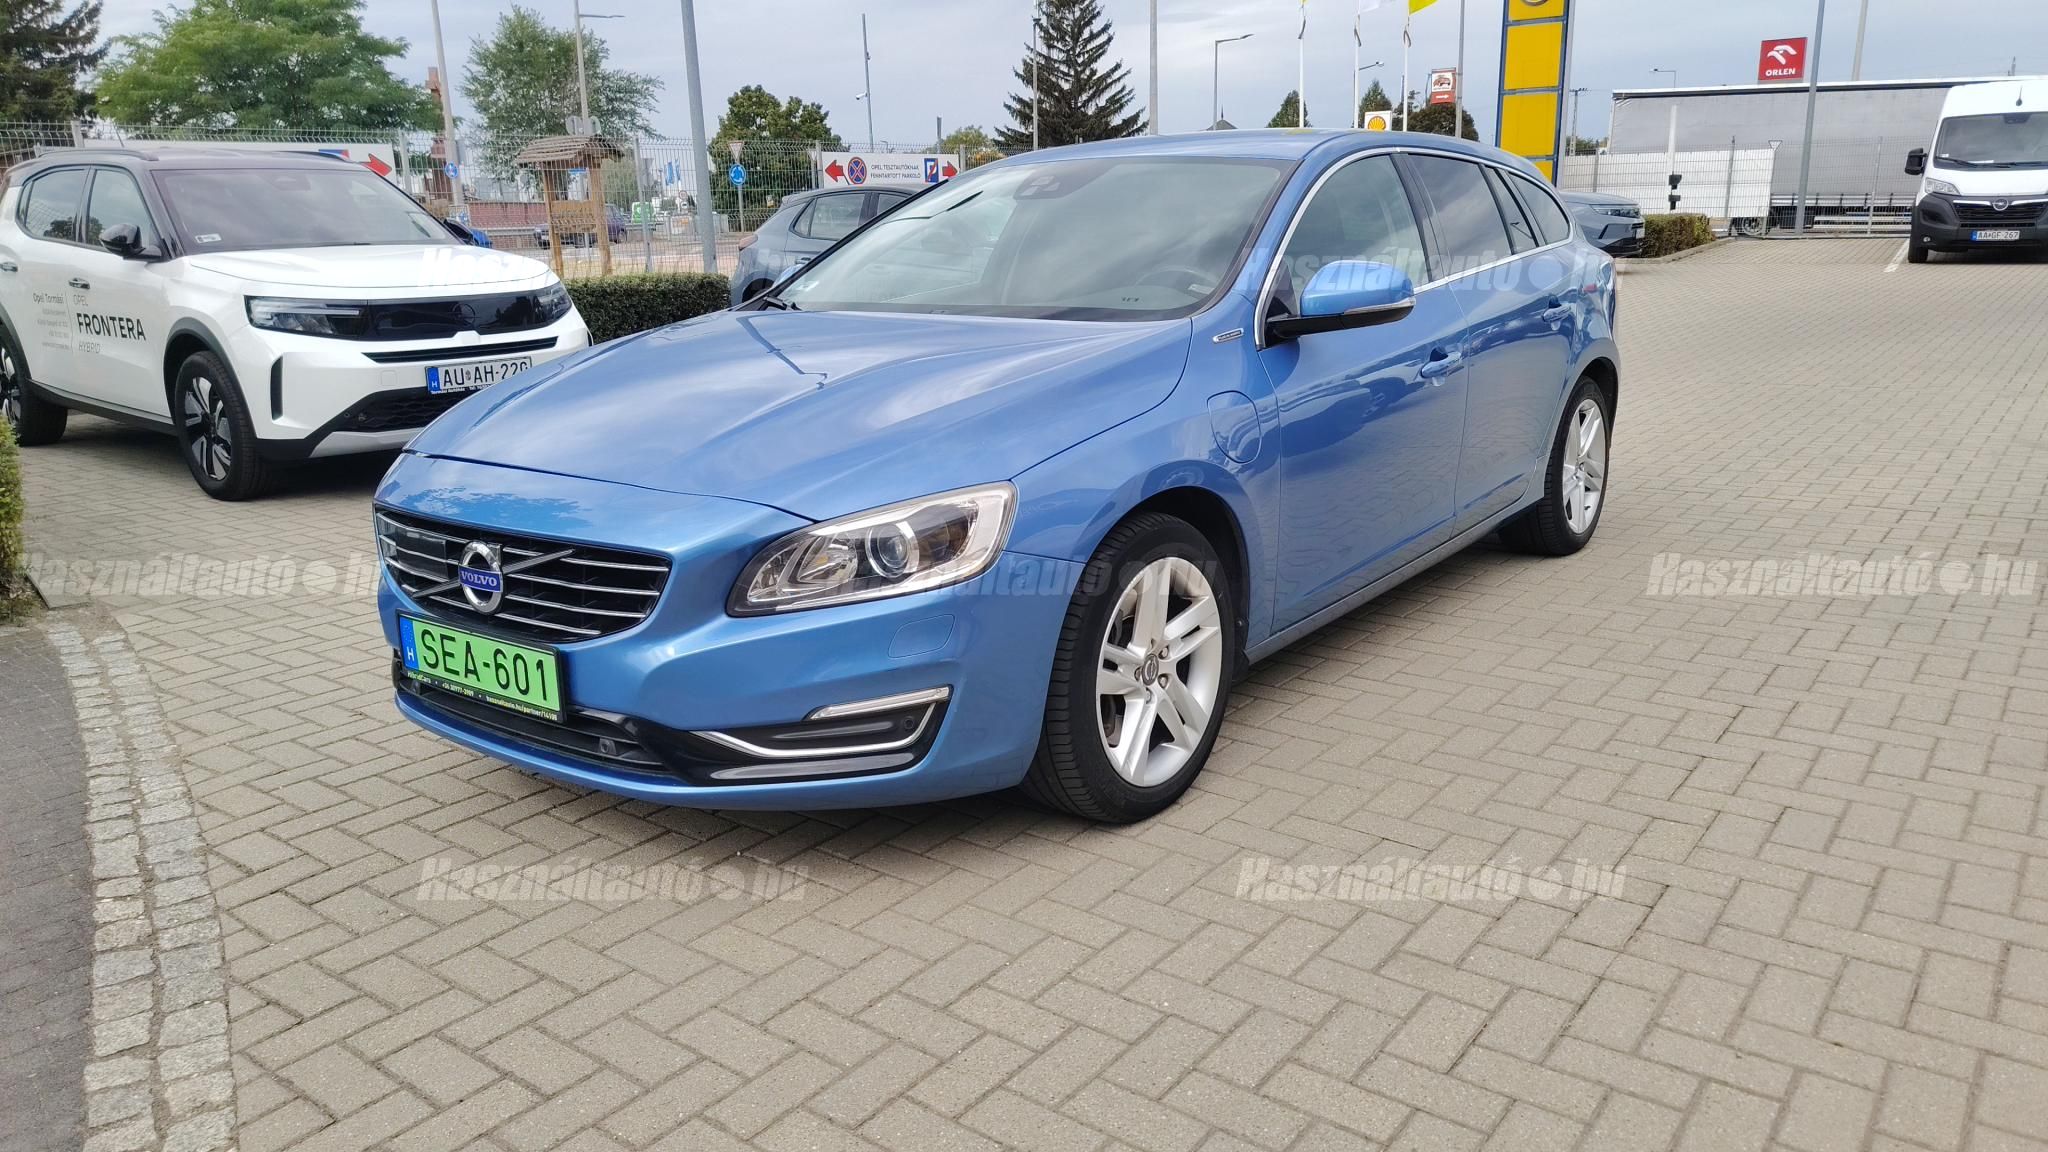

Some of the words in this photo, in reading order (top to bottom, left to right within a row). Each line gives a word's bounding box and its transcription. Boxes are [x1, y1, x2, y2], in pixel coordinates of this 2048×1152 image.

[1765, 67, 1796, 77] ORLEN
[73, 294, 89, 306] OPEL
[76, 312, 146, 341] FRONTERA
[78, 341, 100, 353] HYBRID
[460, 570, 498, 587] VOLVO
[407, 646, 415, 662] H
[420, 628, 548, 701] SEA-601
